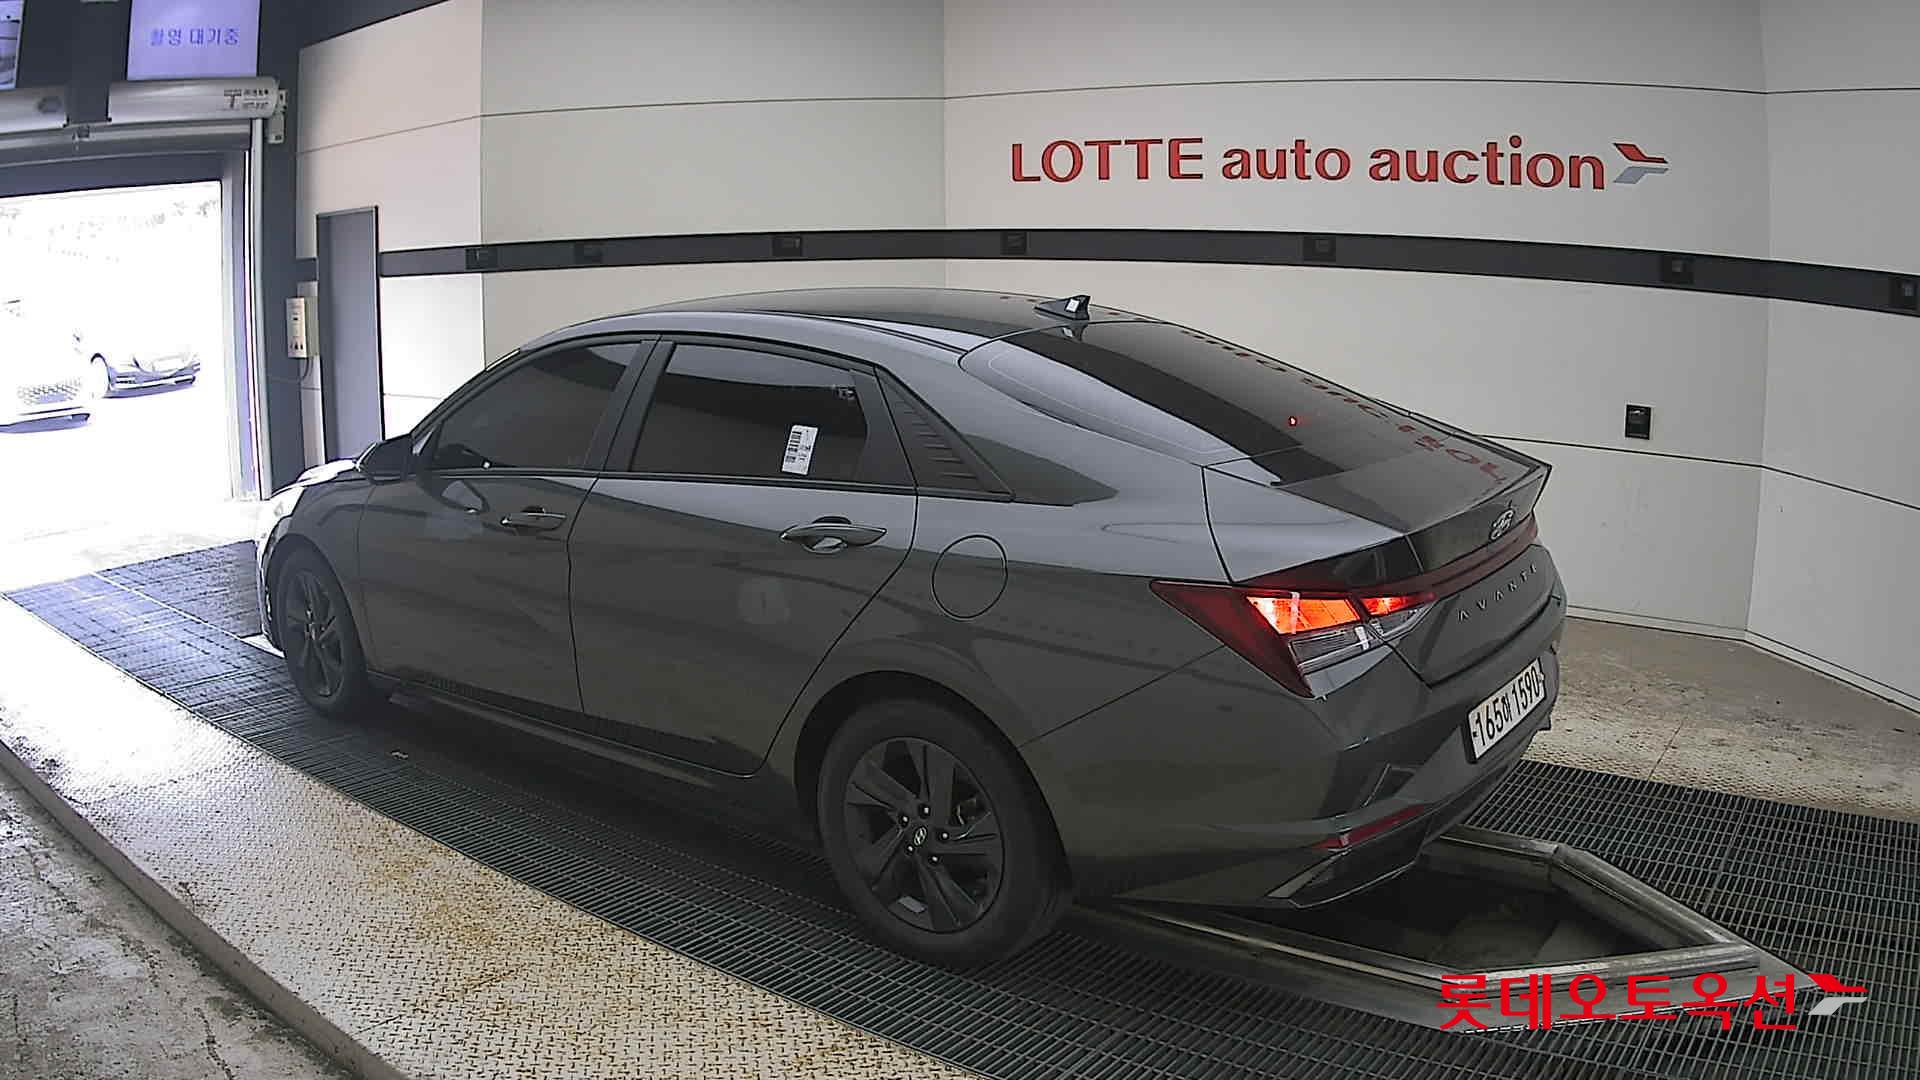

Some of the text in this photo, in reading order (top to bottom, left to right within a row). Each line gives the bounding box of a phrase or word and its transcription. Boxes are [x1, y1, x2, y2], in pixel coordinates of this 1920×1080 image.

[1011, 134, 1605, 190] LOTTE auto auction
[1457, 563, 1537, 621] AVANTE
[1512, 666, 1540, 715] 1590
